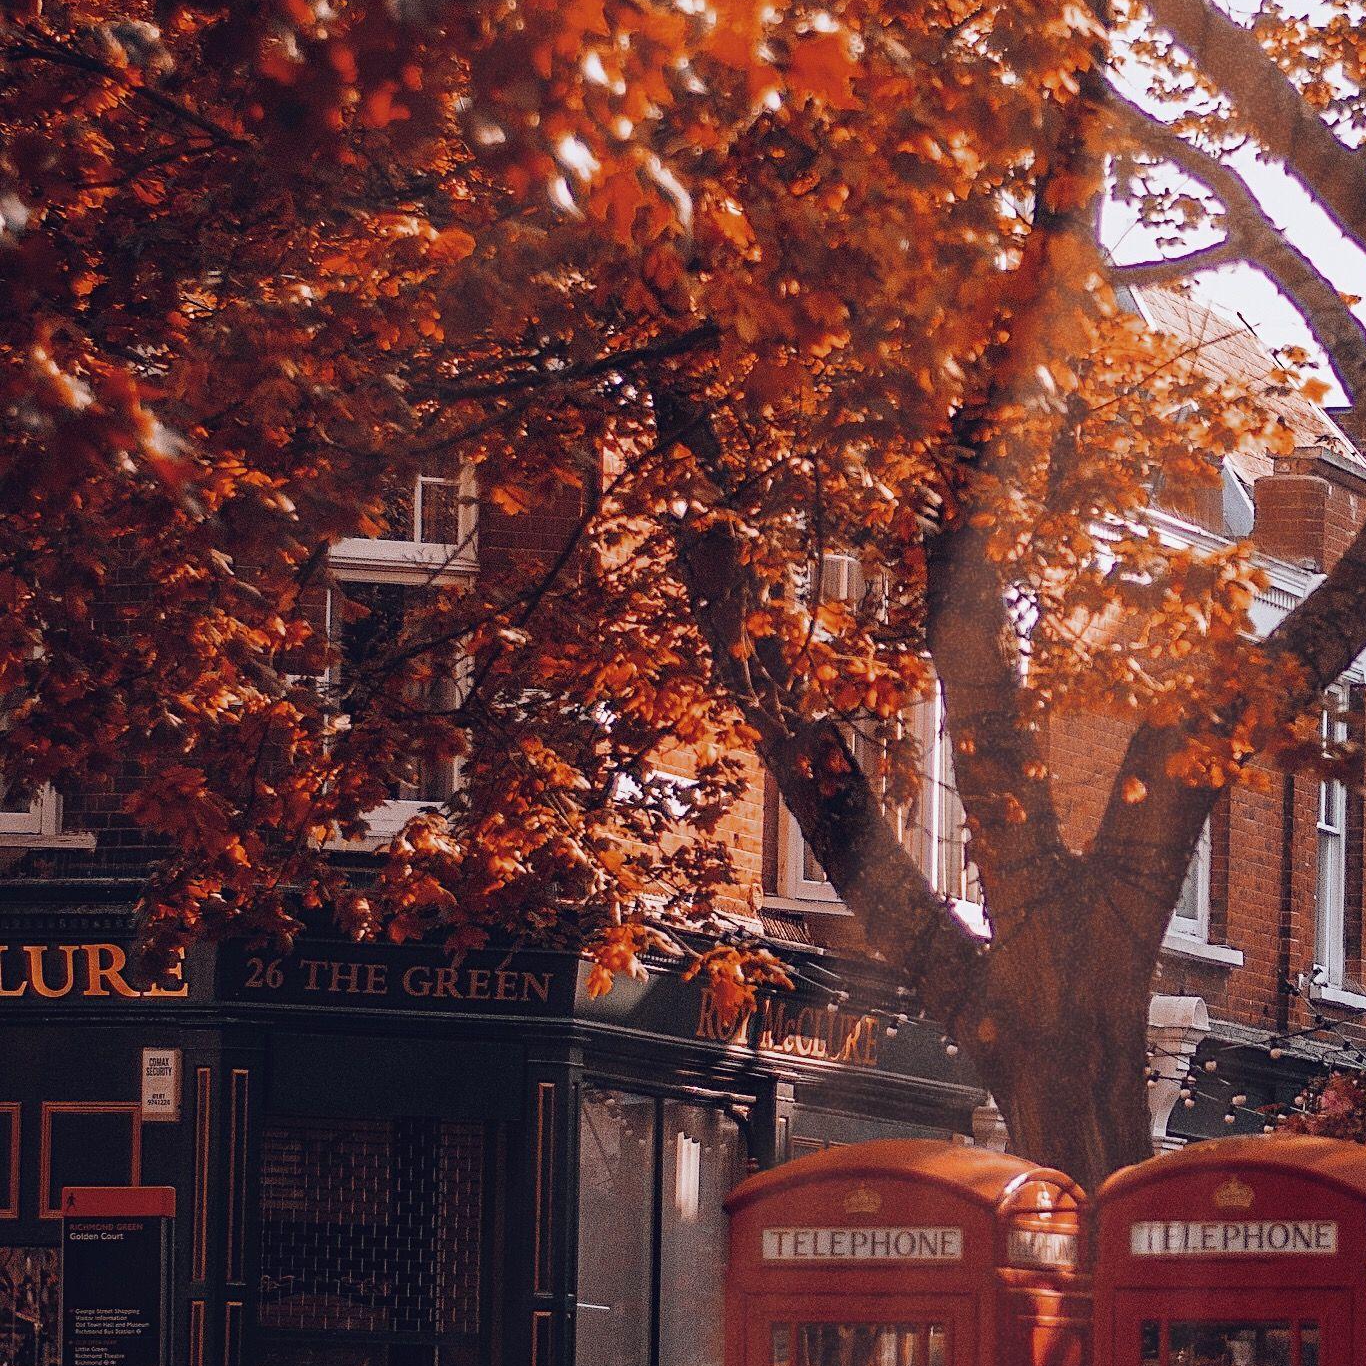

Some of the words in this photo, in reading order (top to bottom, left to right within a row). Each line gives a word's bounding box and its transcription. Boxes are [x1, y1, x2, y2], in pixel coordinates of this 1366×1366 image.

[245, 956, 285, 989] 26
[299, 959, 388, 994] THE
[401, 964, 555, 1003] GREEN
[145, 1066, 173, 1077] SECURITY
[69, 1223, 114, 1231] RICHMOND
[116, 1223, 144, 1231] GREEN
[69, 1232, 99, 1241] Golden
[100, 1232, 124, 1241] Court
[771, 1230, 958, 1258] TELEPHONE
[1143, 1222, 1334, 1252] TELEPHONE
